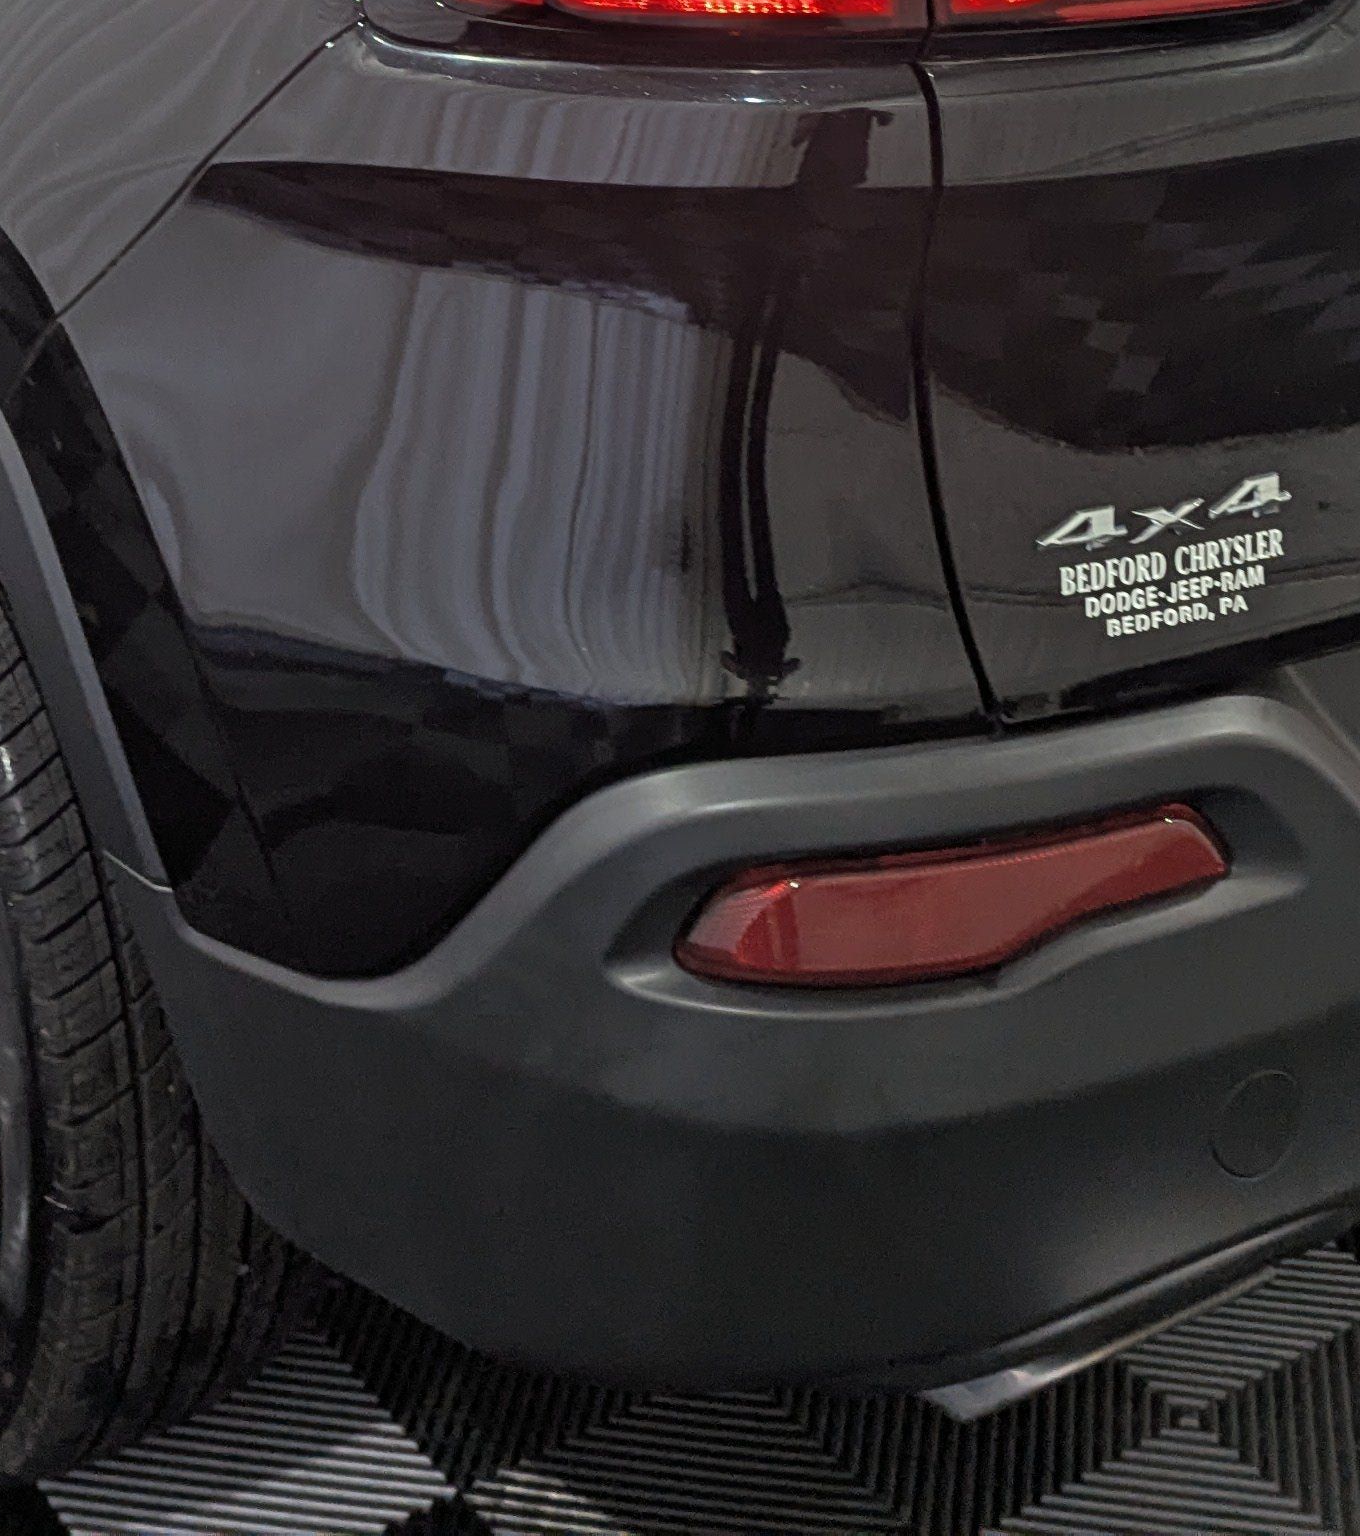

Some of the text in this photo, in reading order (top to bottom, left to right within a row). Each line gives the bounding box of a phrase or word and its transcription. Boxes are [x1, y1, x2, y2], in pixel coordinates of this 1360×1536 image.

[1059, 528, 1284, 596] BEDFORD CHRYSLER
[1219, 594, 1249, 615] PA
